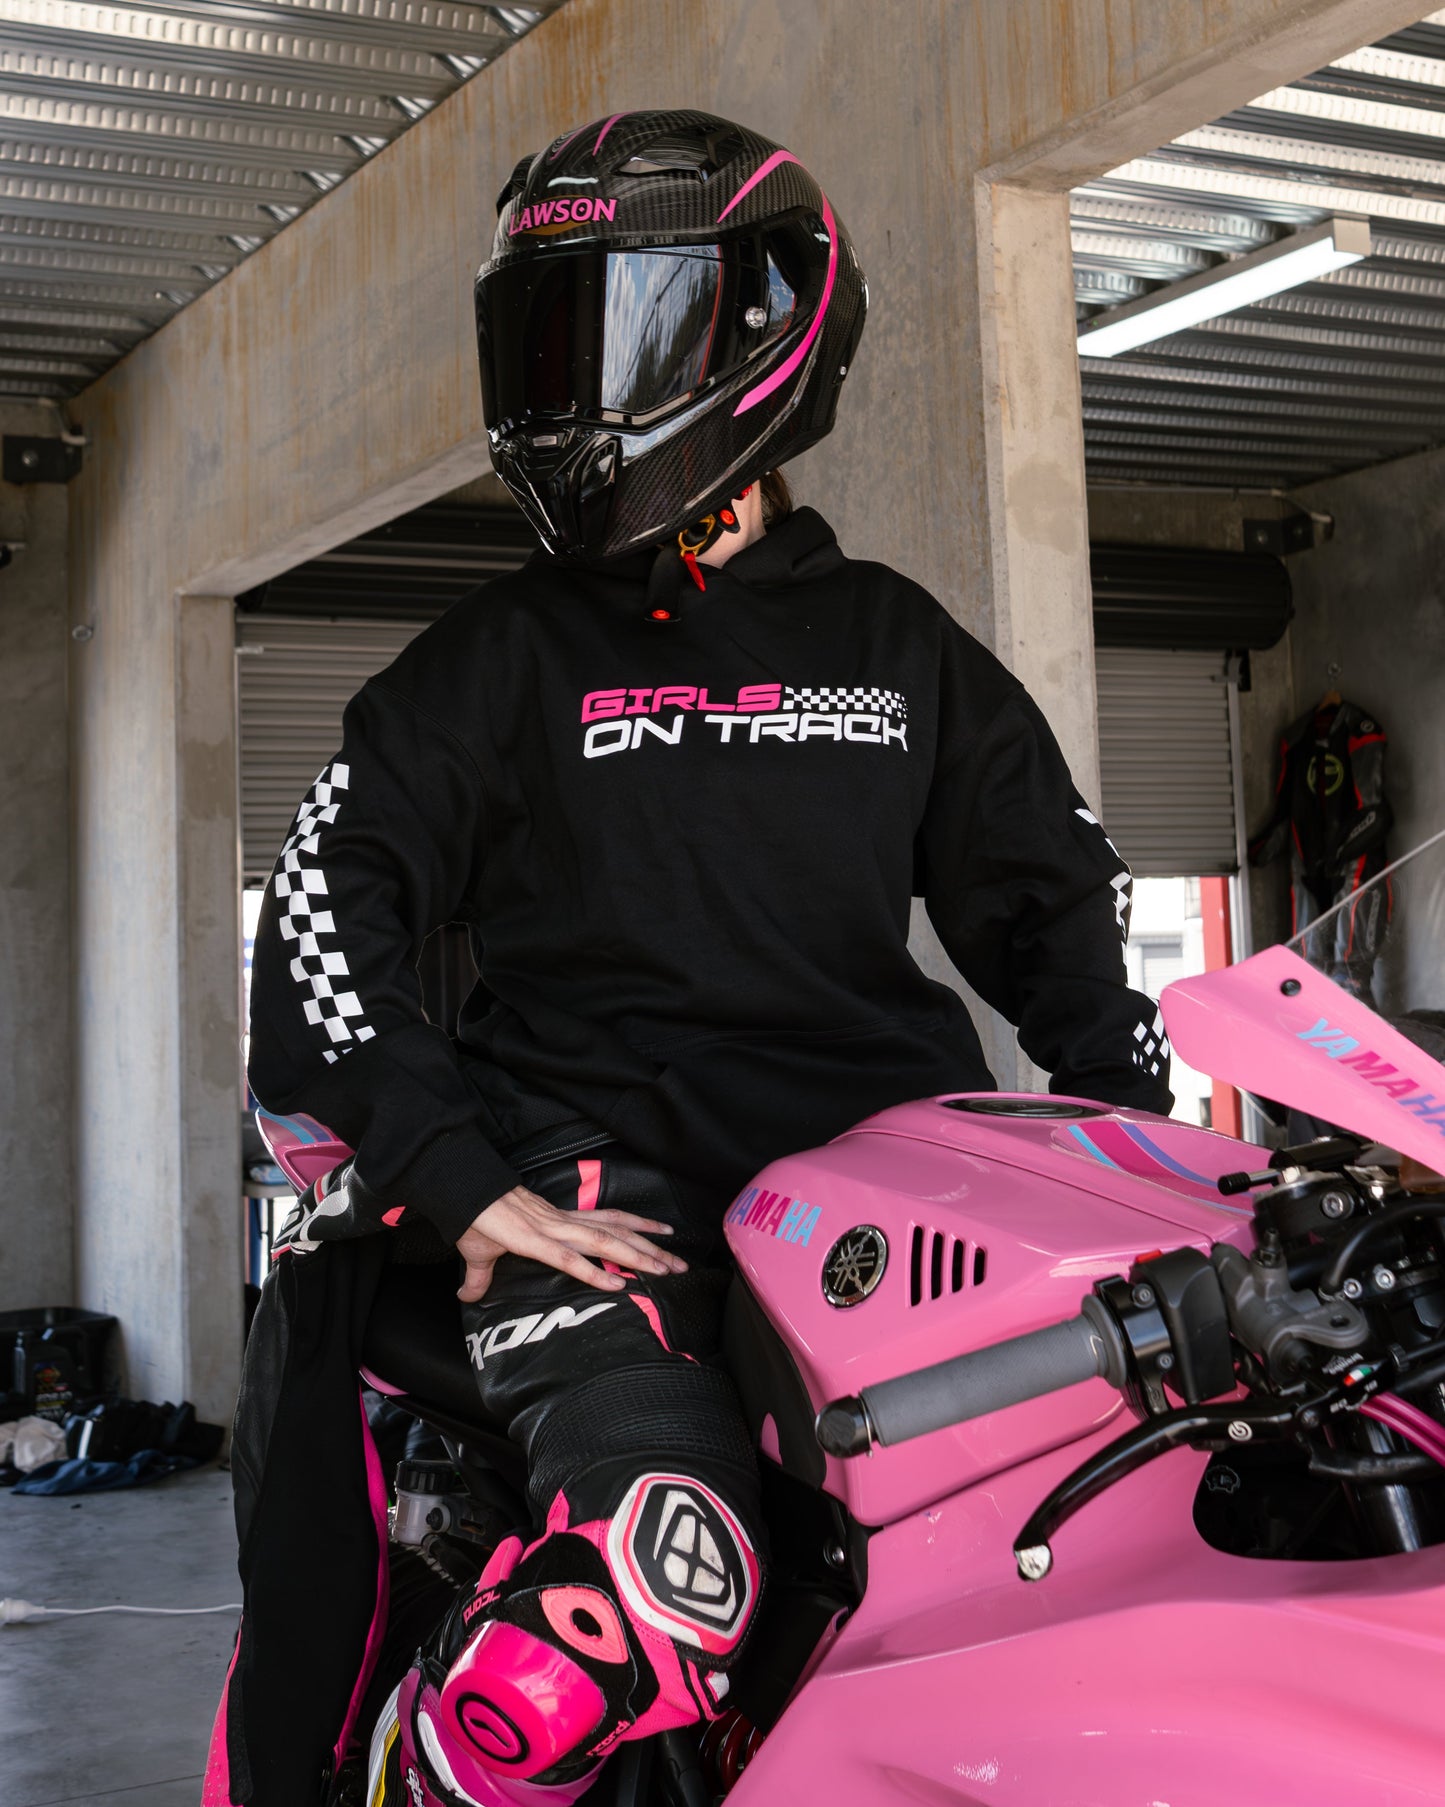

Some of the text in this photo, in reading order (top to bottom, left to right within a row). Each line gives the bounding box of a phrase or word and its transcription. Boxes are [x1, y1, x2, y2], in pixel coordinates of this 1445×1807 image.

[508, 197, 617, 237] LAWSON
[581, 683, 783, 724] GIRLS
[583, 712, 909, 759] ON TRACK
[466, 1302, 618, 1371] XON
